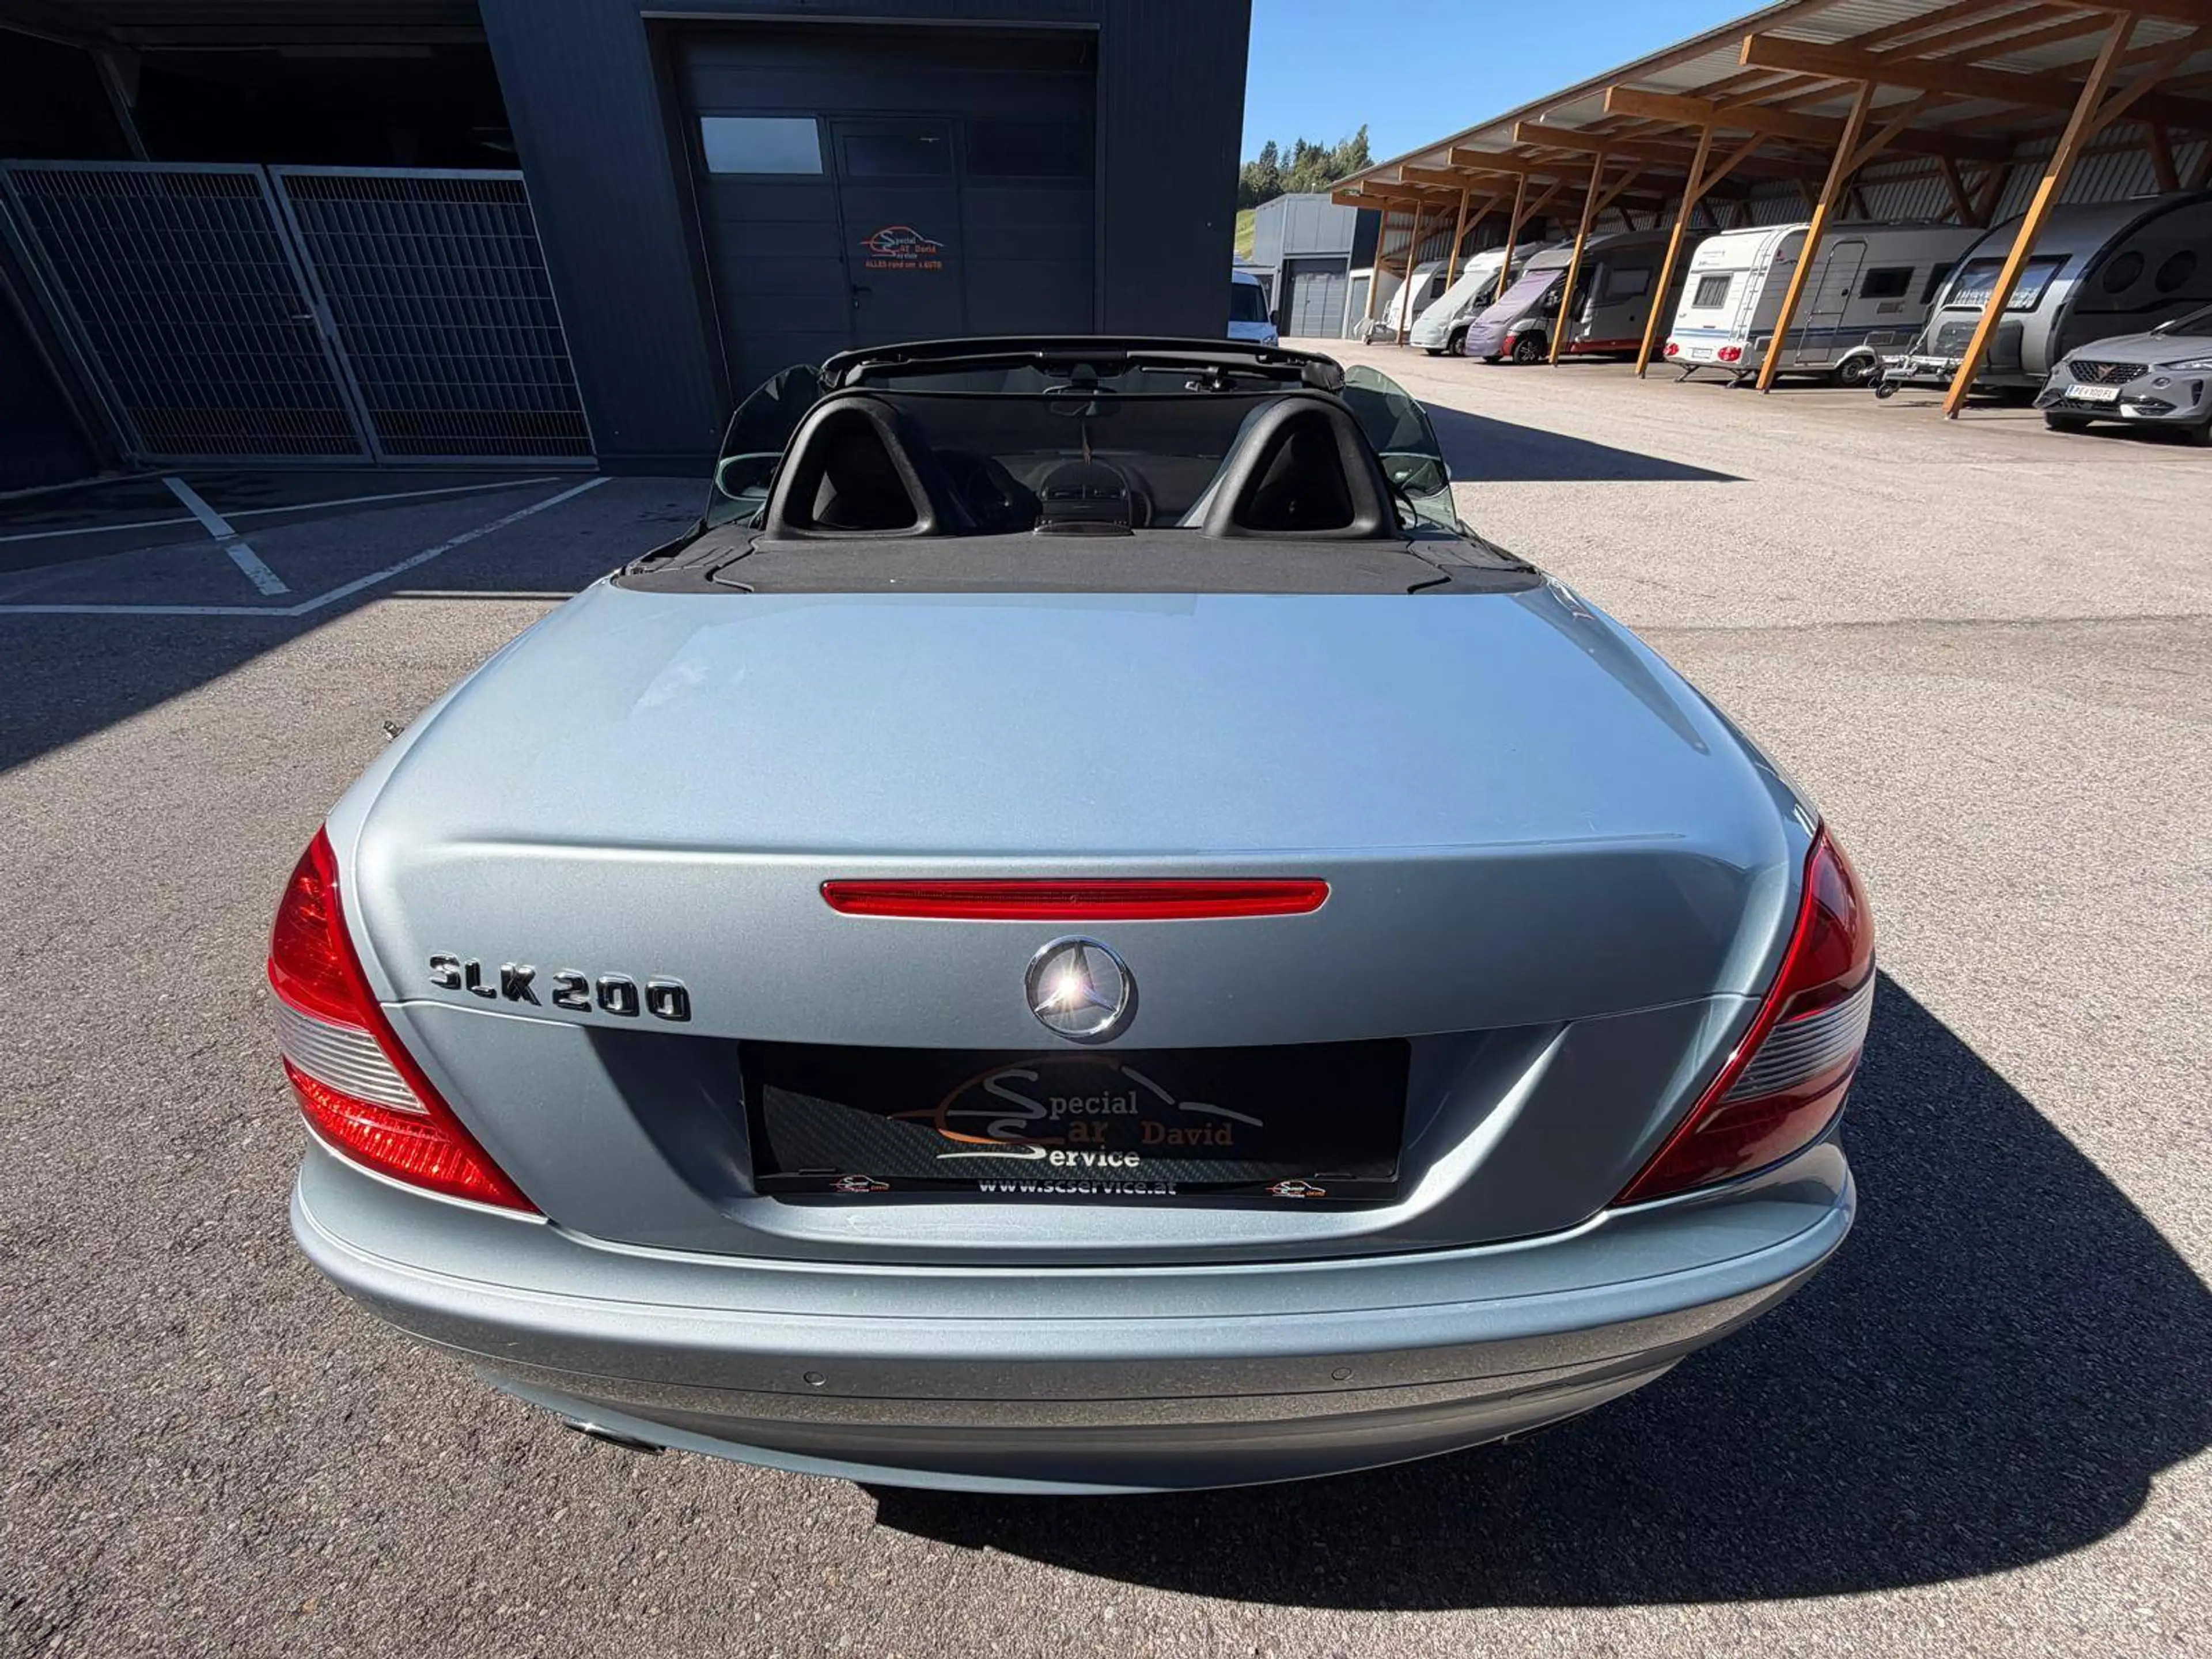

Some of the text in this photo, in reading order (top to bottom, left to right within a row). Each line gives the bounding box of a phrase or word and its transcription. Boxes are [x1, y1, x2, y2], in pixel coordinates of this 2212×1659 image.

[429, 950, 692, 1022] SLK 200
[946, 1068, 1139, 1120] Special
[1140, 1122, 1234, 1146] David
[978, 1179, 1177, 1195] www.scservice.at
